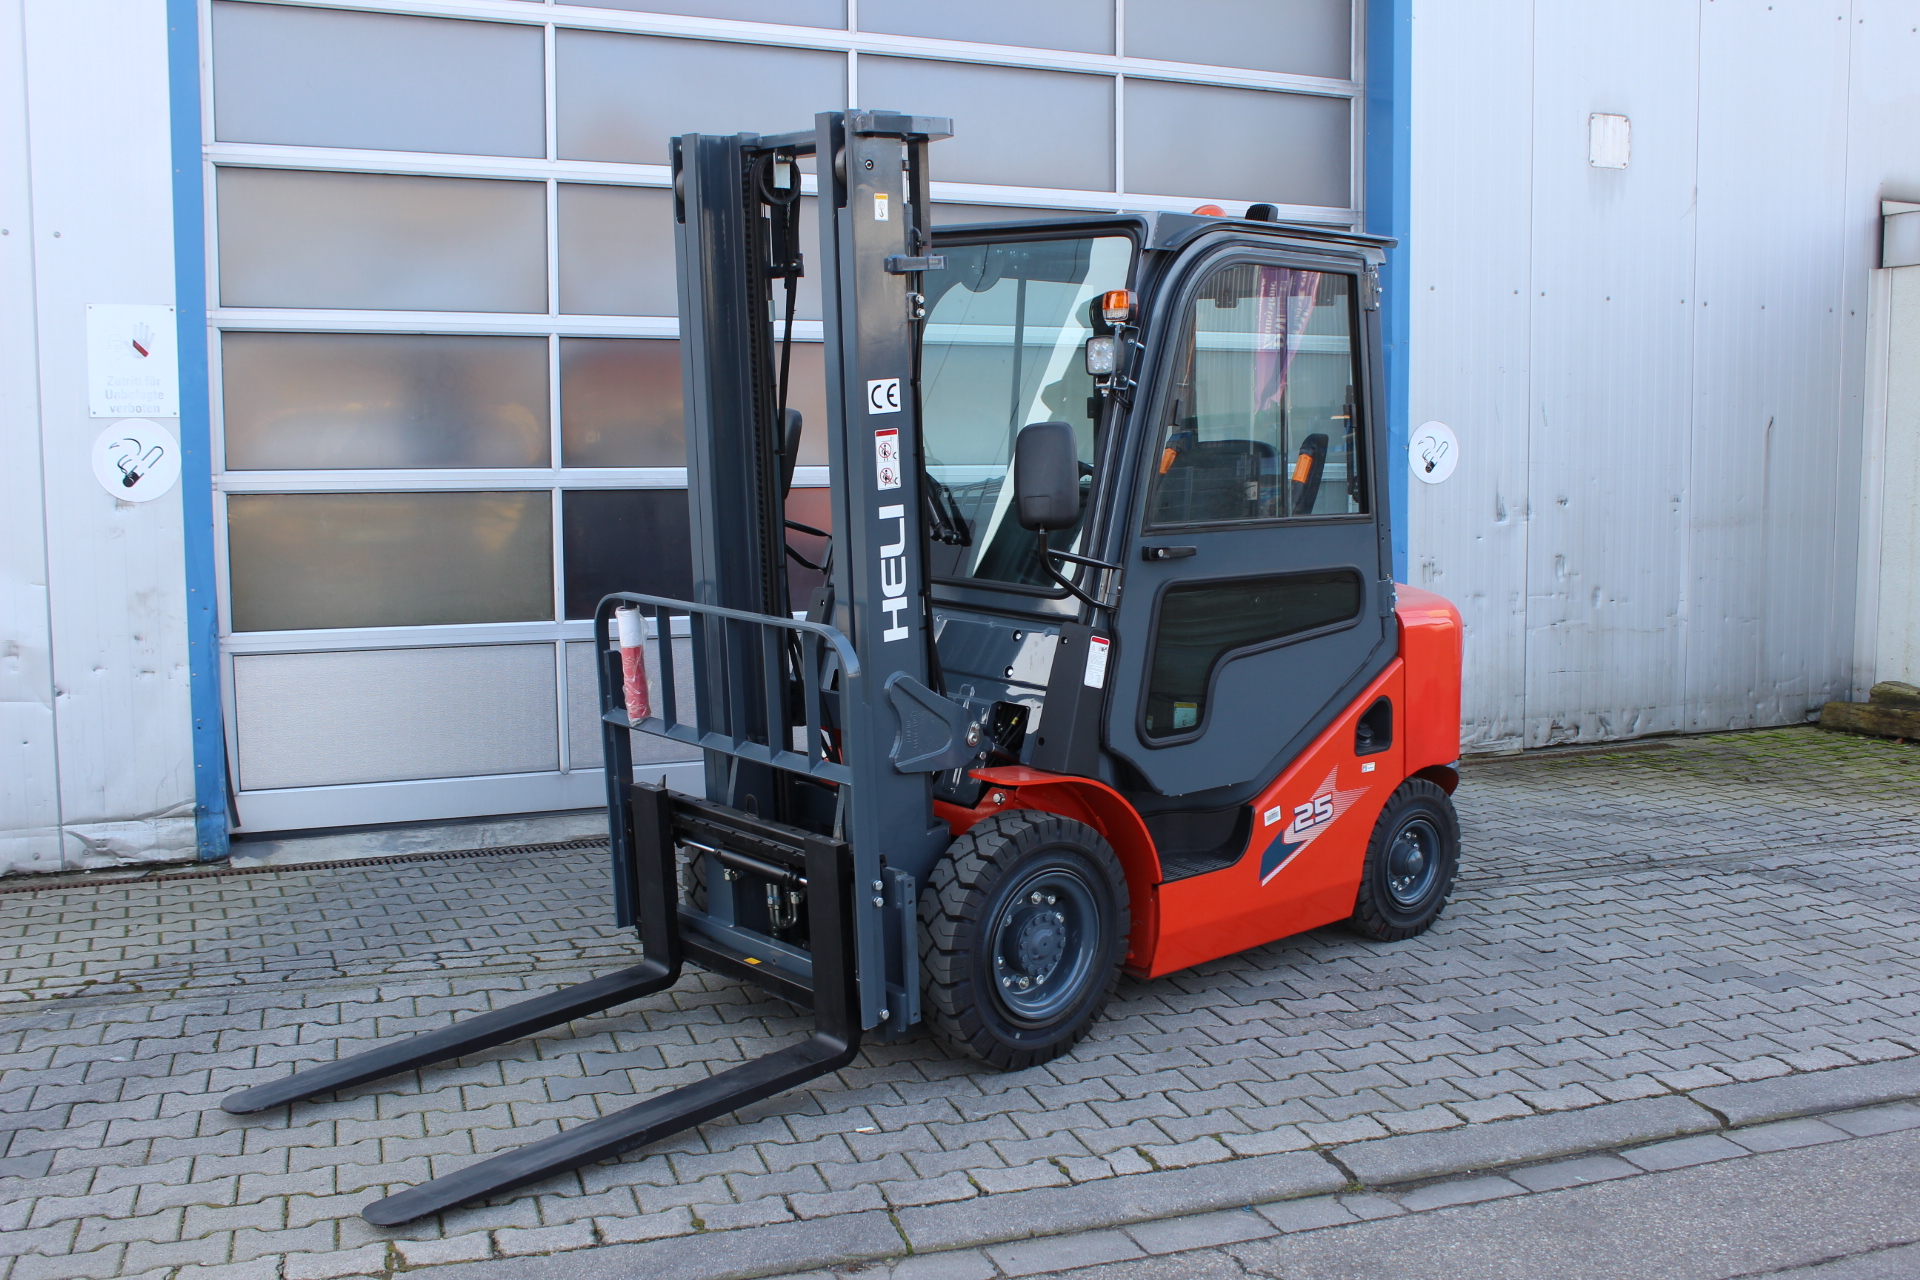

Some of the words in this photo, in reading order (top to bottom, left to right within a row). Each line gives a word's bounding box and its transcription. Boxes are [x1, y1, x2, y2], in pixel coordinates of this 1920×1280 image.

[107, 375, 142, 387] Zutritt
[145, 375, 162, 387] für
[105, 389, 164, 402] Unbefugte
[871, 383, 898, 409] CE
[109, 403, 161, 413] verboten
[879, 504, 909, 642] HELI
[1294, 791, 1334, 833] 25
